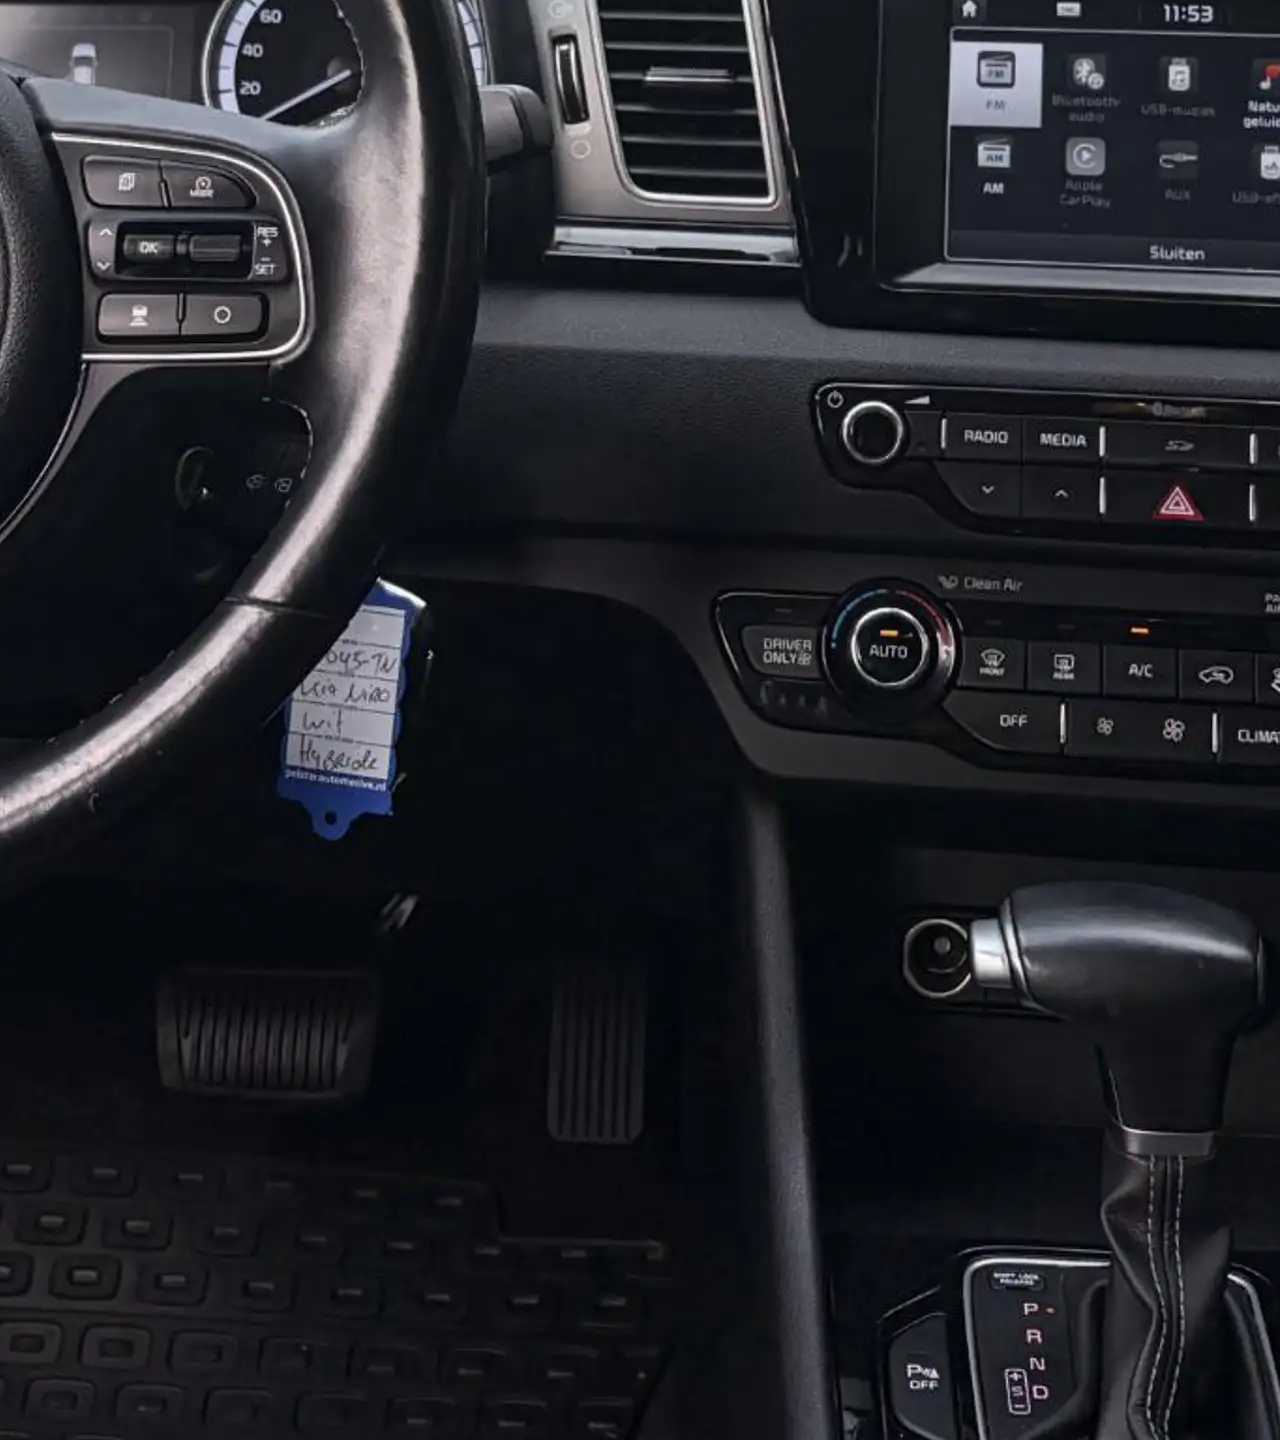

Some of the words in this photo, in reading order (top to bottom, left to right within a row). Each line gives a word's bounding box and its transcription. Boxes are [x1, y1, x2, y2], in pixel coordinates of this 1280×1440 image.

[260, 8, 282, 23] 60
[1163, 4, 1214, 23] 11:53
[242, 43, 264, 58] 40
[239, 80, 261, 96] 20
[983, 182, 1004, 195] AM
[257, 227, 279, 238] RES
[138, 241, 159, 254] OK
[1149, 244, 1206, 261] Sluiten
[254, 263, 275, 276] SET
[963, 429, 1009, 444] RADIO
[1040, 433, 1088, 448] MEDIA
[964, 576, 1000, 591] Clean
[1003, 578, 1023, 592] Air
[763, 637, 812, 652] DRIVER
[869, 644, 908, 659] AUTO
[763, 651, 798, 665] ONLY
[1128, 663, 1154, 679] A/C
[999, 713, 1028, 728] OFF
[1023, 1302, 1039, 1316] P
[1026, 1329, 1043, 1344] R
[1029, 1357, 1046, 1371] N
[909, 1380, 939, 1390] OFF
[1032, 1385, 1049, 1400] D
